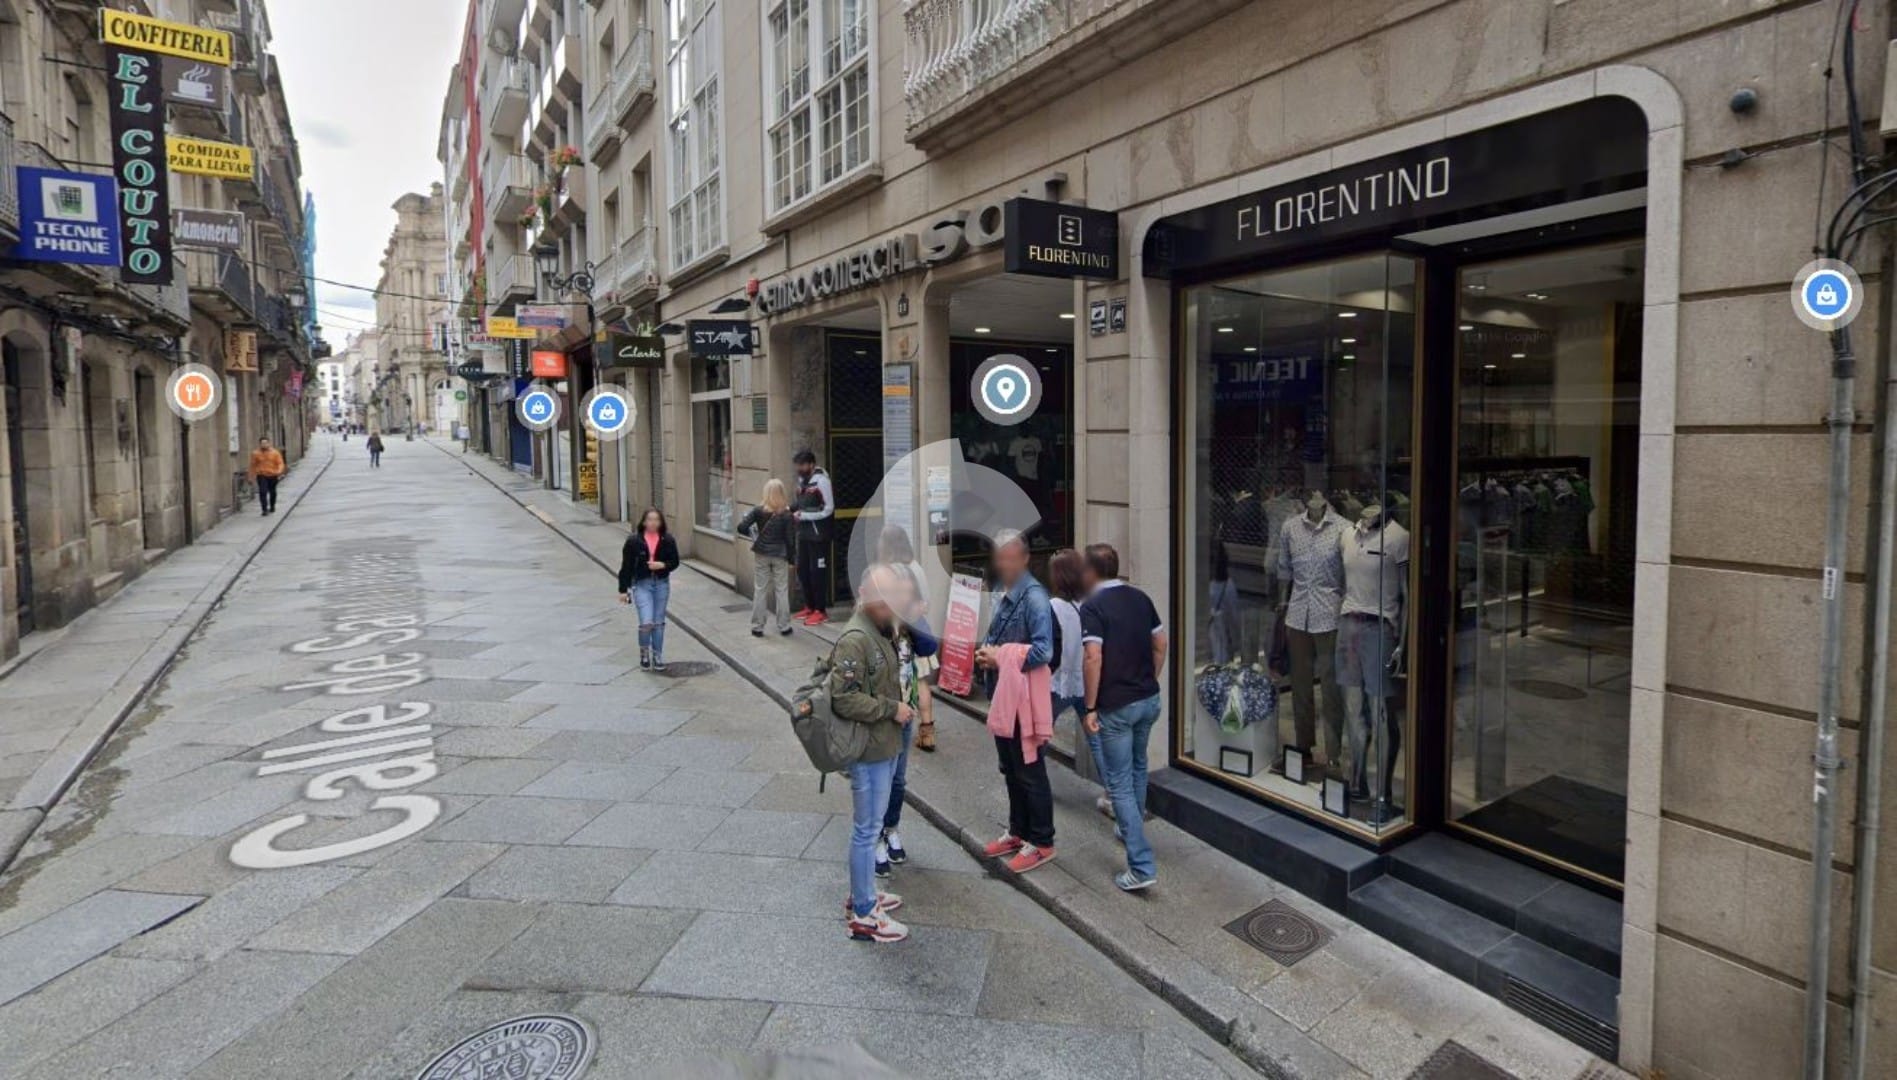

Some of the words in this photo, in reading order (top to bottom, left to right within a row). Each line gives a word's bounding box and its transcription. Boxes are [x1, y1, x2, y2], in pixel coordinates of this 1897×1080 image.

[111, 17, 225, 58] CONFITERIA
[115, 53, 153, 113] EL
[168, 155, 203, 169] PARA
[206, 159, 251, 174] LLEVAR
[177, 143, 240, 160] COMIDAS
[120, 129, 161, 274] COUTO
[1238, 156, 1450, 241] FLORENTINO
[34, 221, 109, 239] TECNIC
[920, 203, 1005, 261] SO
[35, 238, 111, 255] PHONE
[1029, 245, 1110, 269] FLORENTINO
[756, 275, 809, 315] CENTRO
[811, 233, 919, 297] COMERCIAL
[618, 345, 661, 357] Clarks
